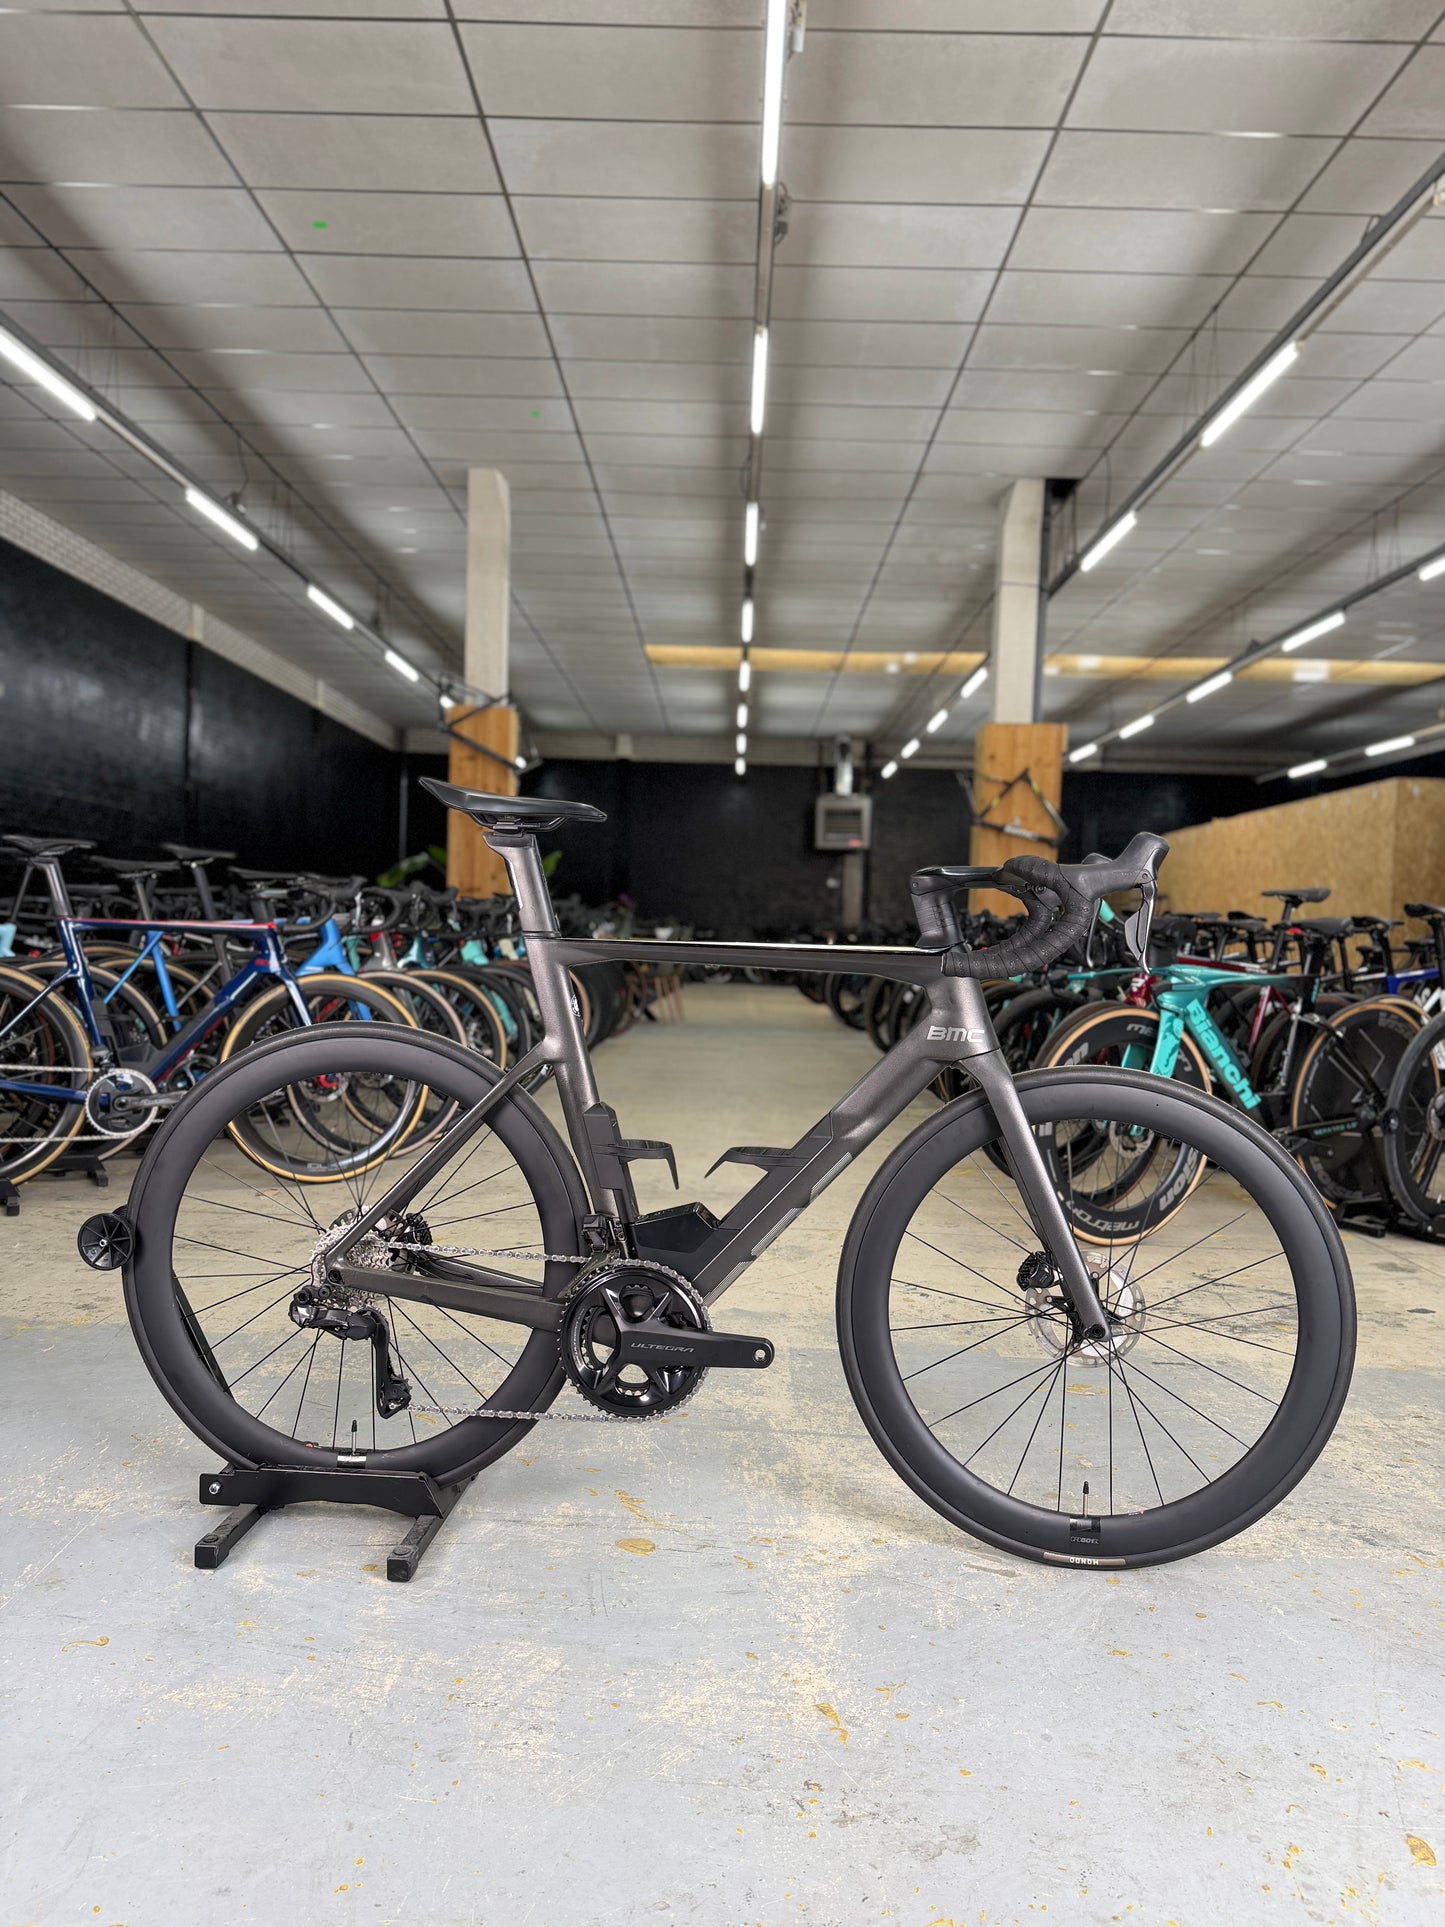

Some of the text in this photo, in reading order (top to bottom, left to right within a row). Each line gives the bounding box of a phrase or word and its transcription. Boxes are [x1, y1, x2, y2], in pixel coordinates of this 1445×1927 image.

[927, 1025, 984, 1042] BMC
[1186, 998, 1261, 1109] Bianchi
[631, 1342, 696, 1353] ULTEGRA
[1069, 1557, 1099, 1566] MONDO
